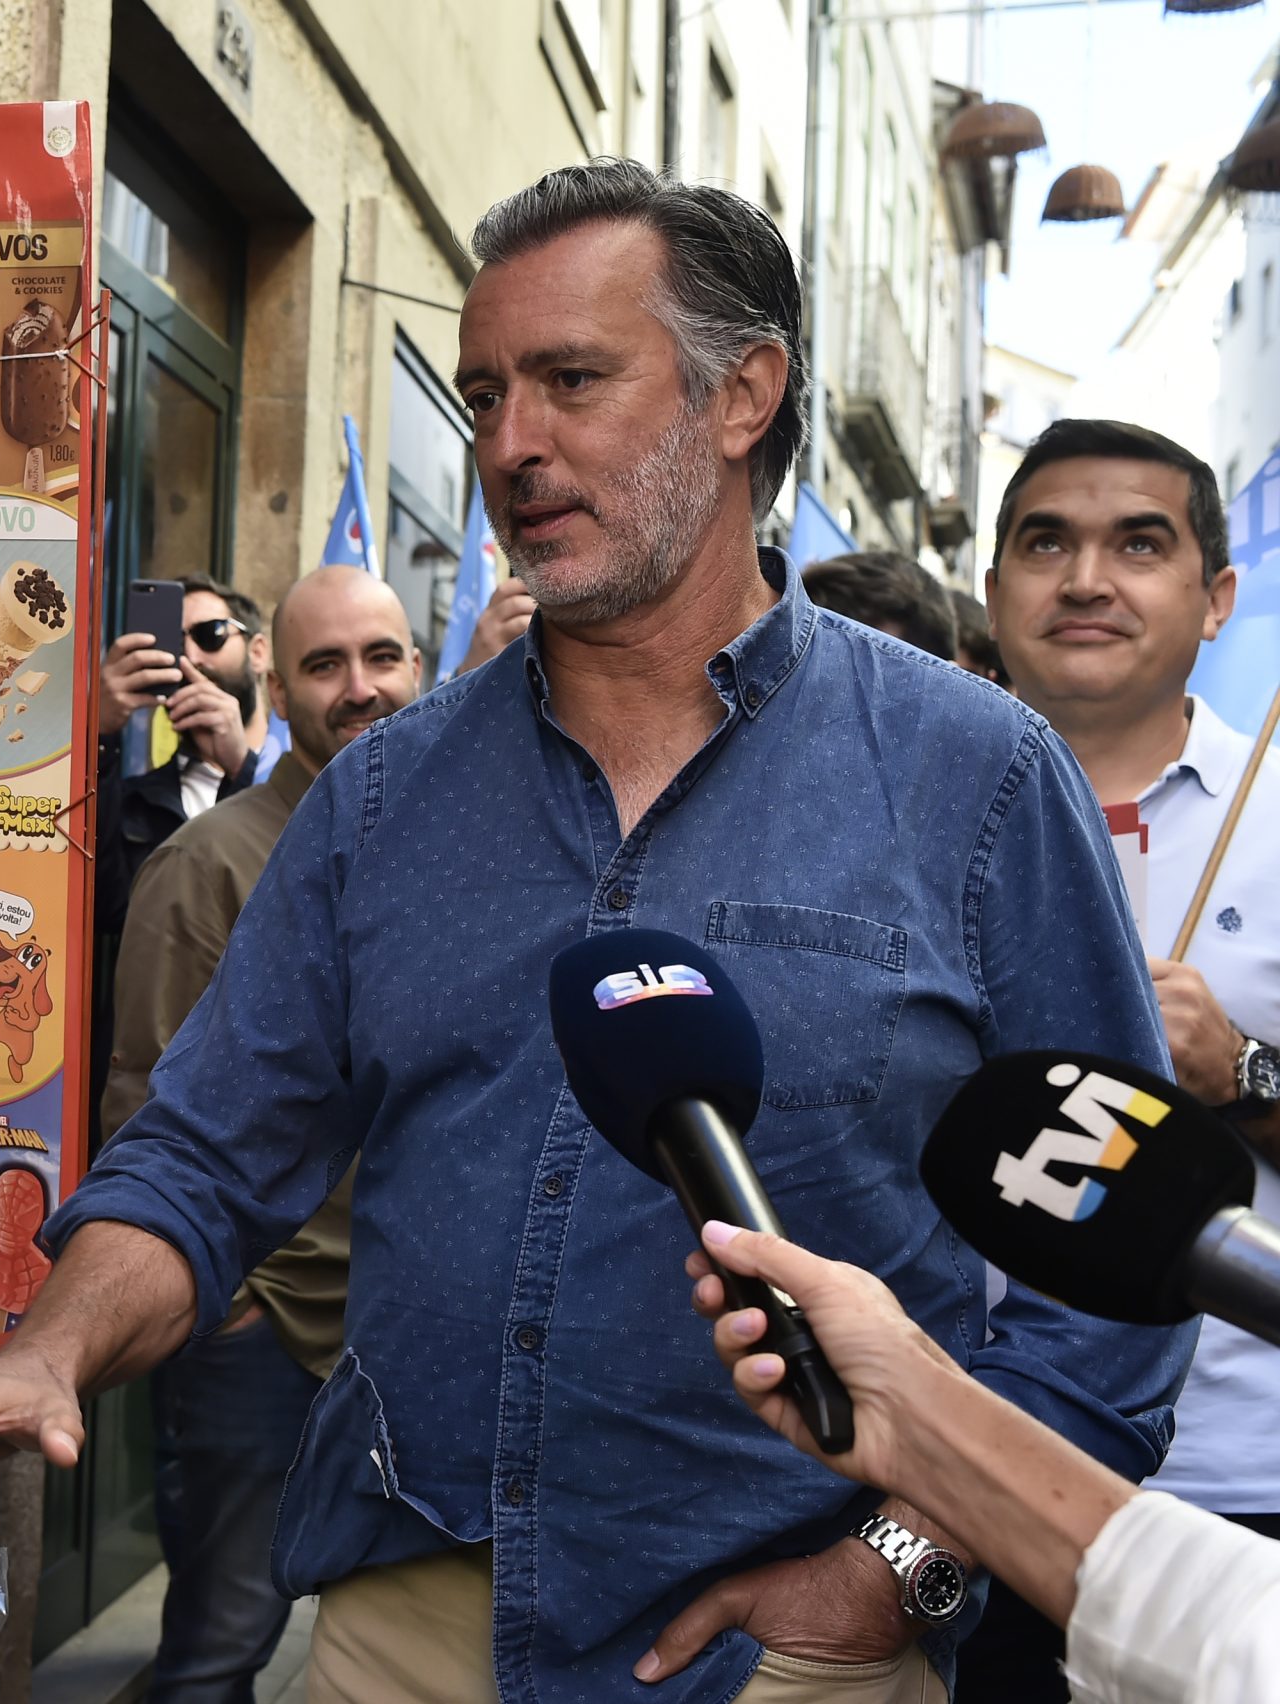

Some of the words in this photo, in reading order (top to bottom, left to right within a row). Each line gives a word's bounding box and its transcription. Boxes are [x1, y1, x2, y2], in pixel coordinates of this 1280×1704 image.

[11, 276, 66, 285] CHOCOLATE
[14, 287, 21, 295] &
[23, 286, 63, 295] COOKIES
[50, 445, 75, 462] 1,80€
[6, 903, 31, 918] estou
[606, 963, 700, 1000] sic
[992, 1063, 1172, 1223] tvi
